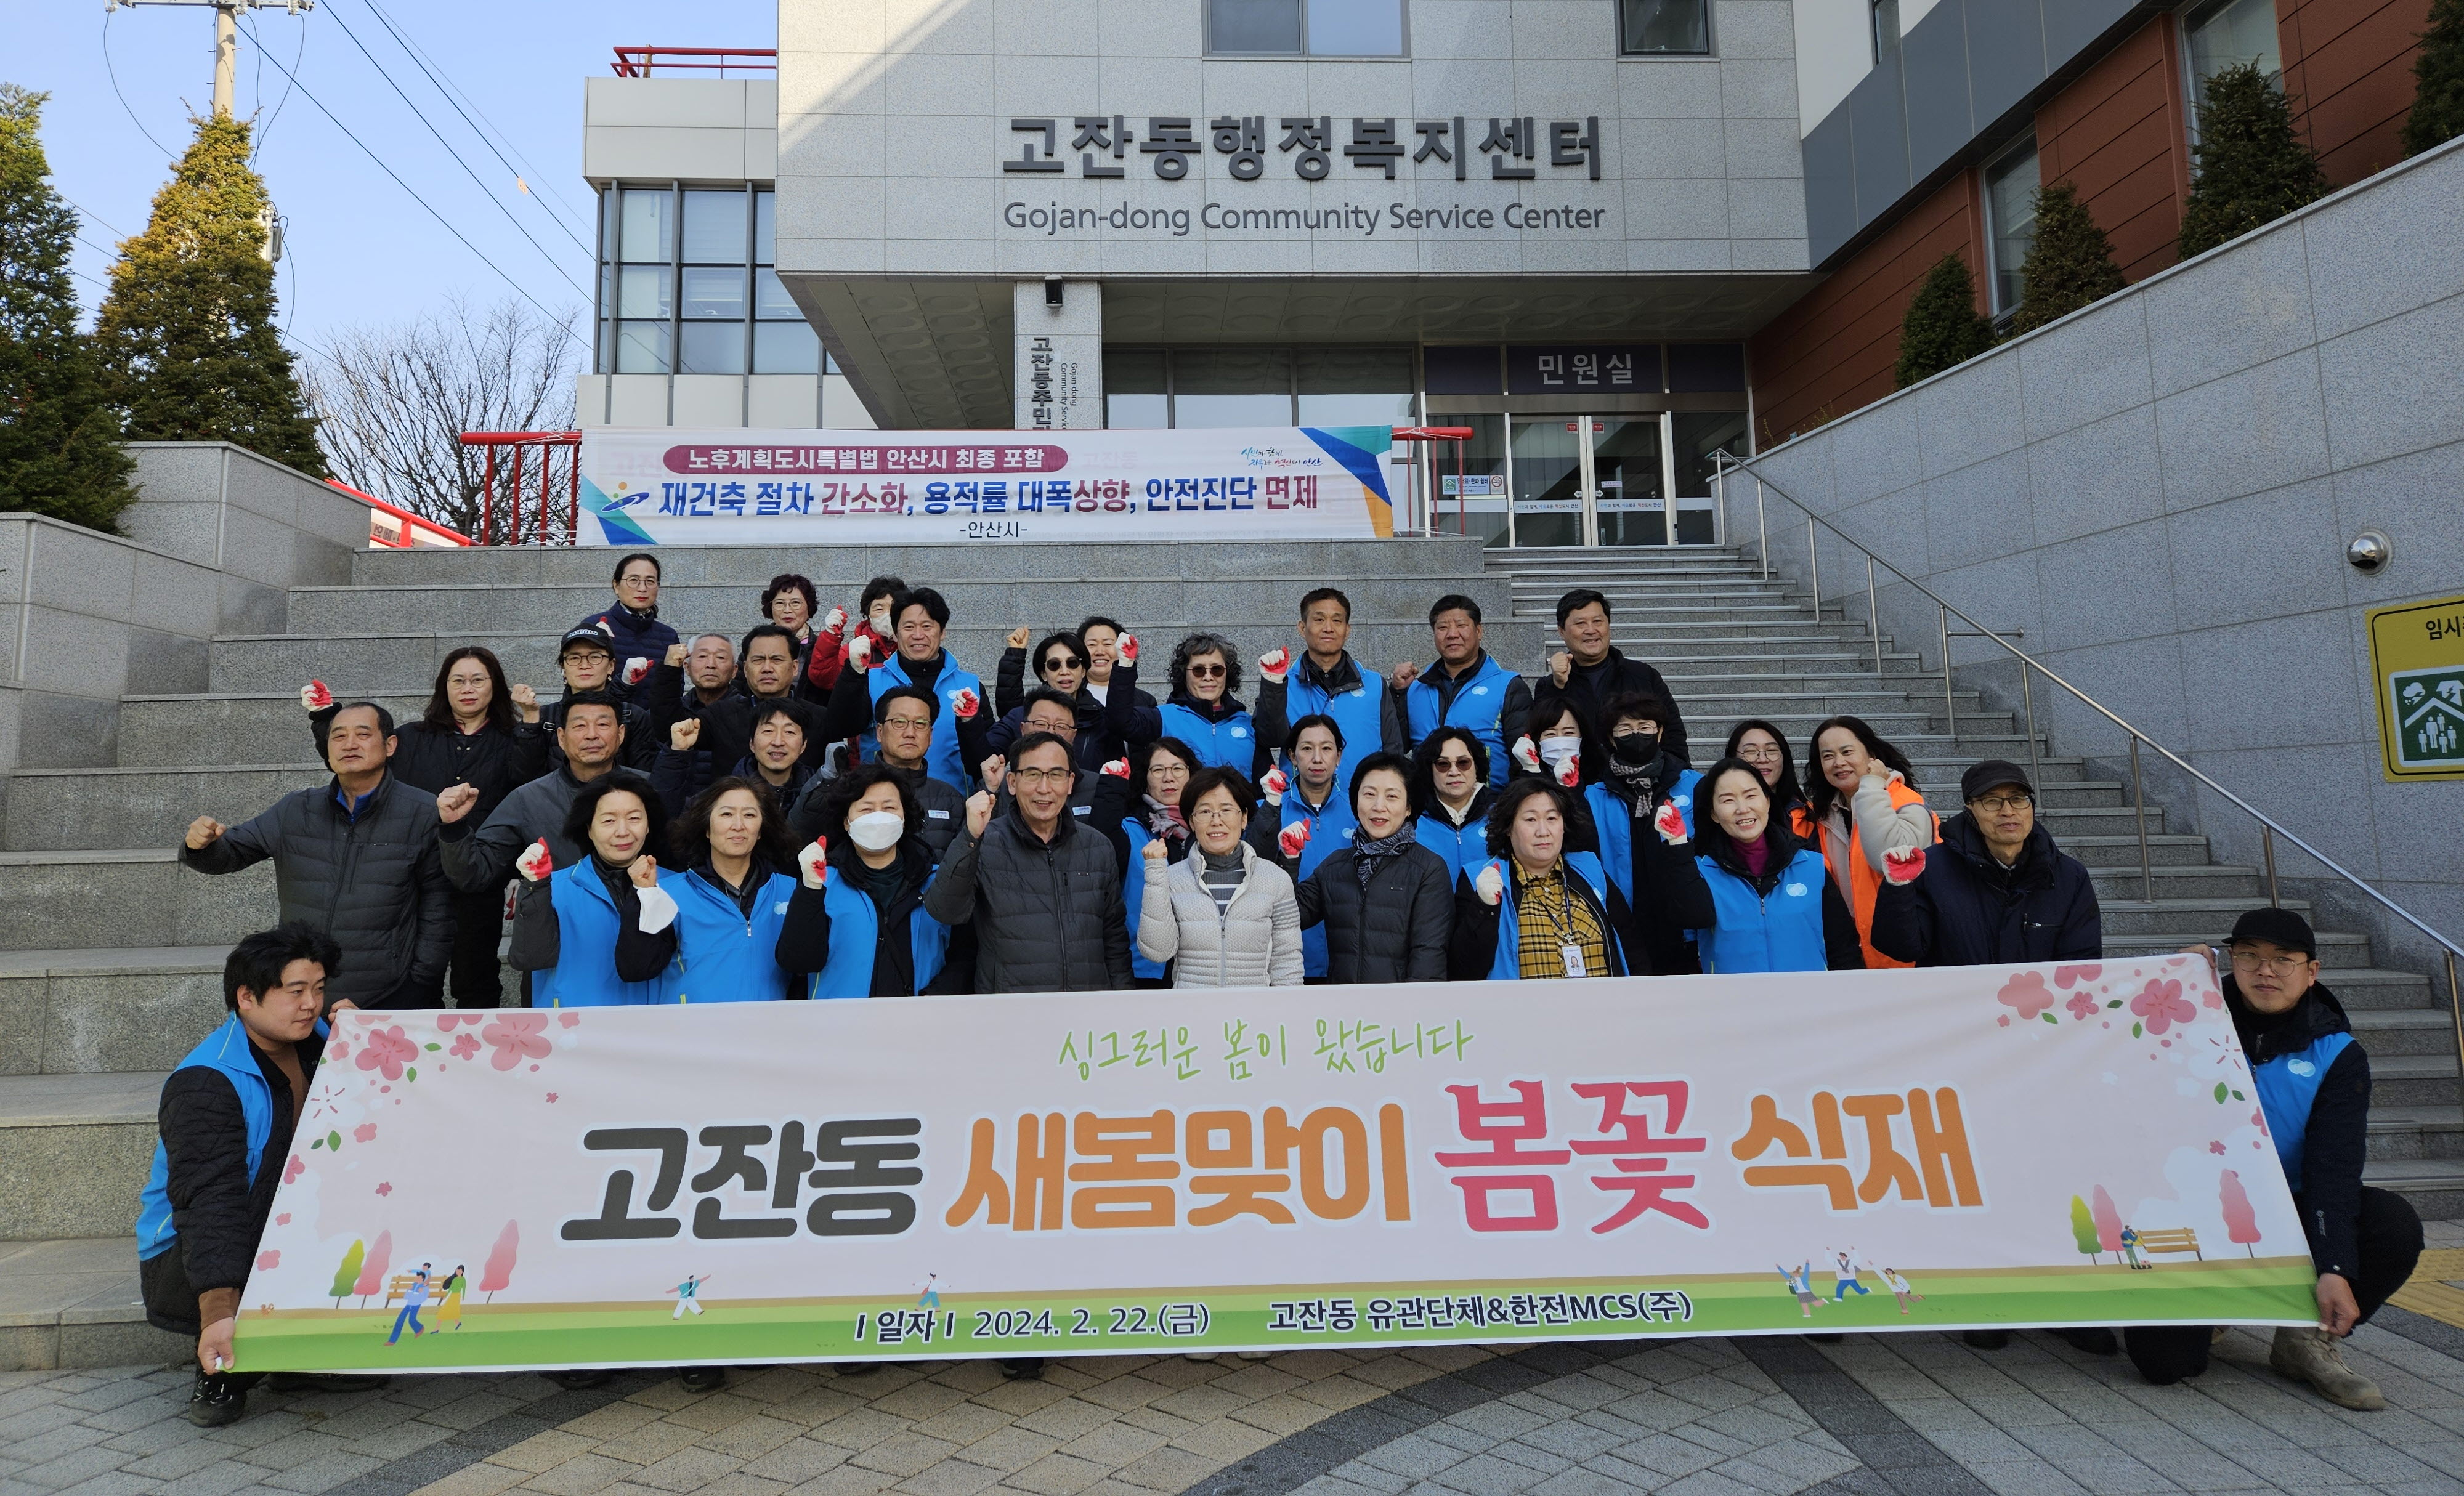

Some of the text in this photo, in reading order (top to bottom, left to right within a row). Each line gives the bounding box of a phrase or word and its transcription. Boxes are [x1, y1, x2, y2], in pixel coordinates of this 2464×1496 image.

[1003, 115, 1603, 180] 고잔동행정복지센터
[1003, 201, 1605, 236] Gojan-dong Community Service Center
[1031, 337, 1053, 429] 고잔동주민
[1060, 362, 1068, 405] Community
[1069, 362, 1078, 406] Gojan-dong
[1539, 354, 1633, 384] 민원실
[689, 448, 1045, 470] 노후계획도시특별법 안산시 최종 포함
[659, 475, 1318, 516] 재건축 절차 간소화, 용적률 대폭상향, 안전진단 면제
[2426, 616, 2464, 640] 임시
[1058, 1019, 1475, 1082] 싱그러운 봄이 왔습니다
[561, 1080, 1984, 1241] 고잔동 새봄맞이 봄꽃 식재
[878, 1310, 936, 1342] 일자
[974, 1310, 1059, 1336] 2024.
[1072, 1309, 1097, 1335] 2.
[1110, 1303, 1209, 1335] 22.(금)
[1269, 1291, 1692, 1330] 고잔동 유관단체&한전MCS(주)
